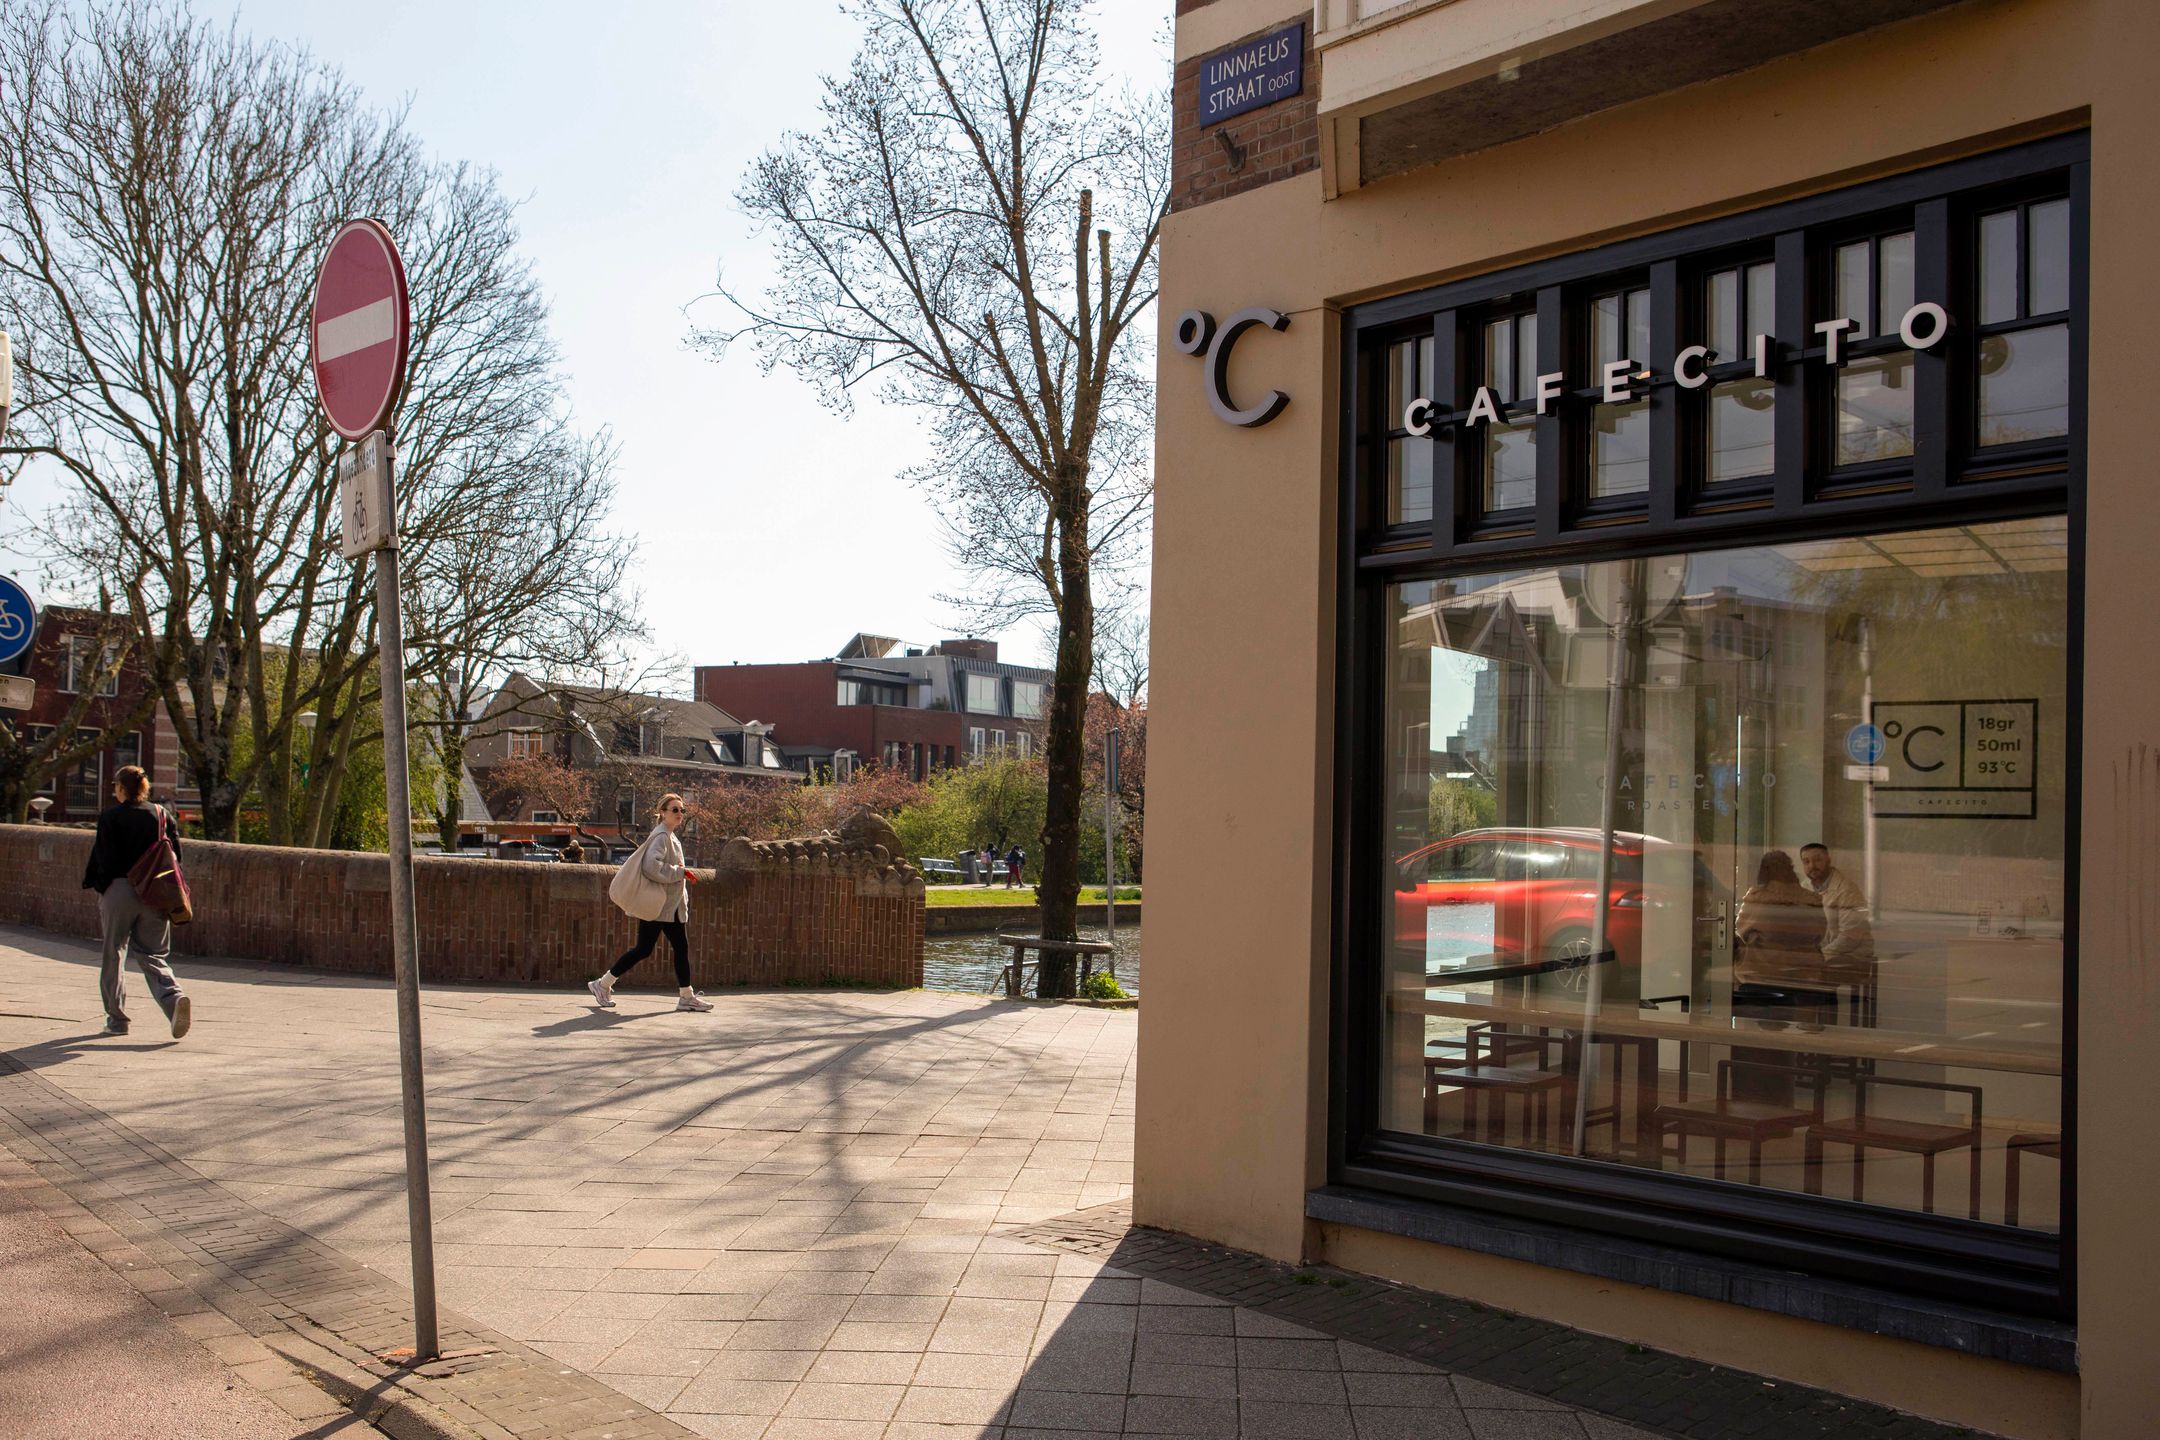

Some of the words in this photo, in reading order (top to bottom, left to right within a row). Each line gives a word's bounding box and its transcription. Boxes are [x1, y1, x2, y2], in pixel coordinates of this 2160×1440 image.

[1210, 37, 1289, 86] LINNAEUS
[1209, 74, 1265, 114] STRAAT
[1268, 70, 1296, 92] OOST
[1404, 302, 1948, 437] CAFECITO
[1978, 718, 2015, 732] 18gr
[1977, 739, 2021, 752] 50ml
[1978, 761, 2016, 774] 93°C
